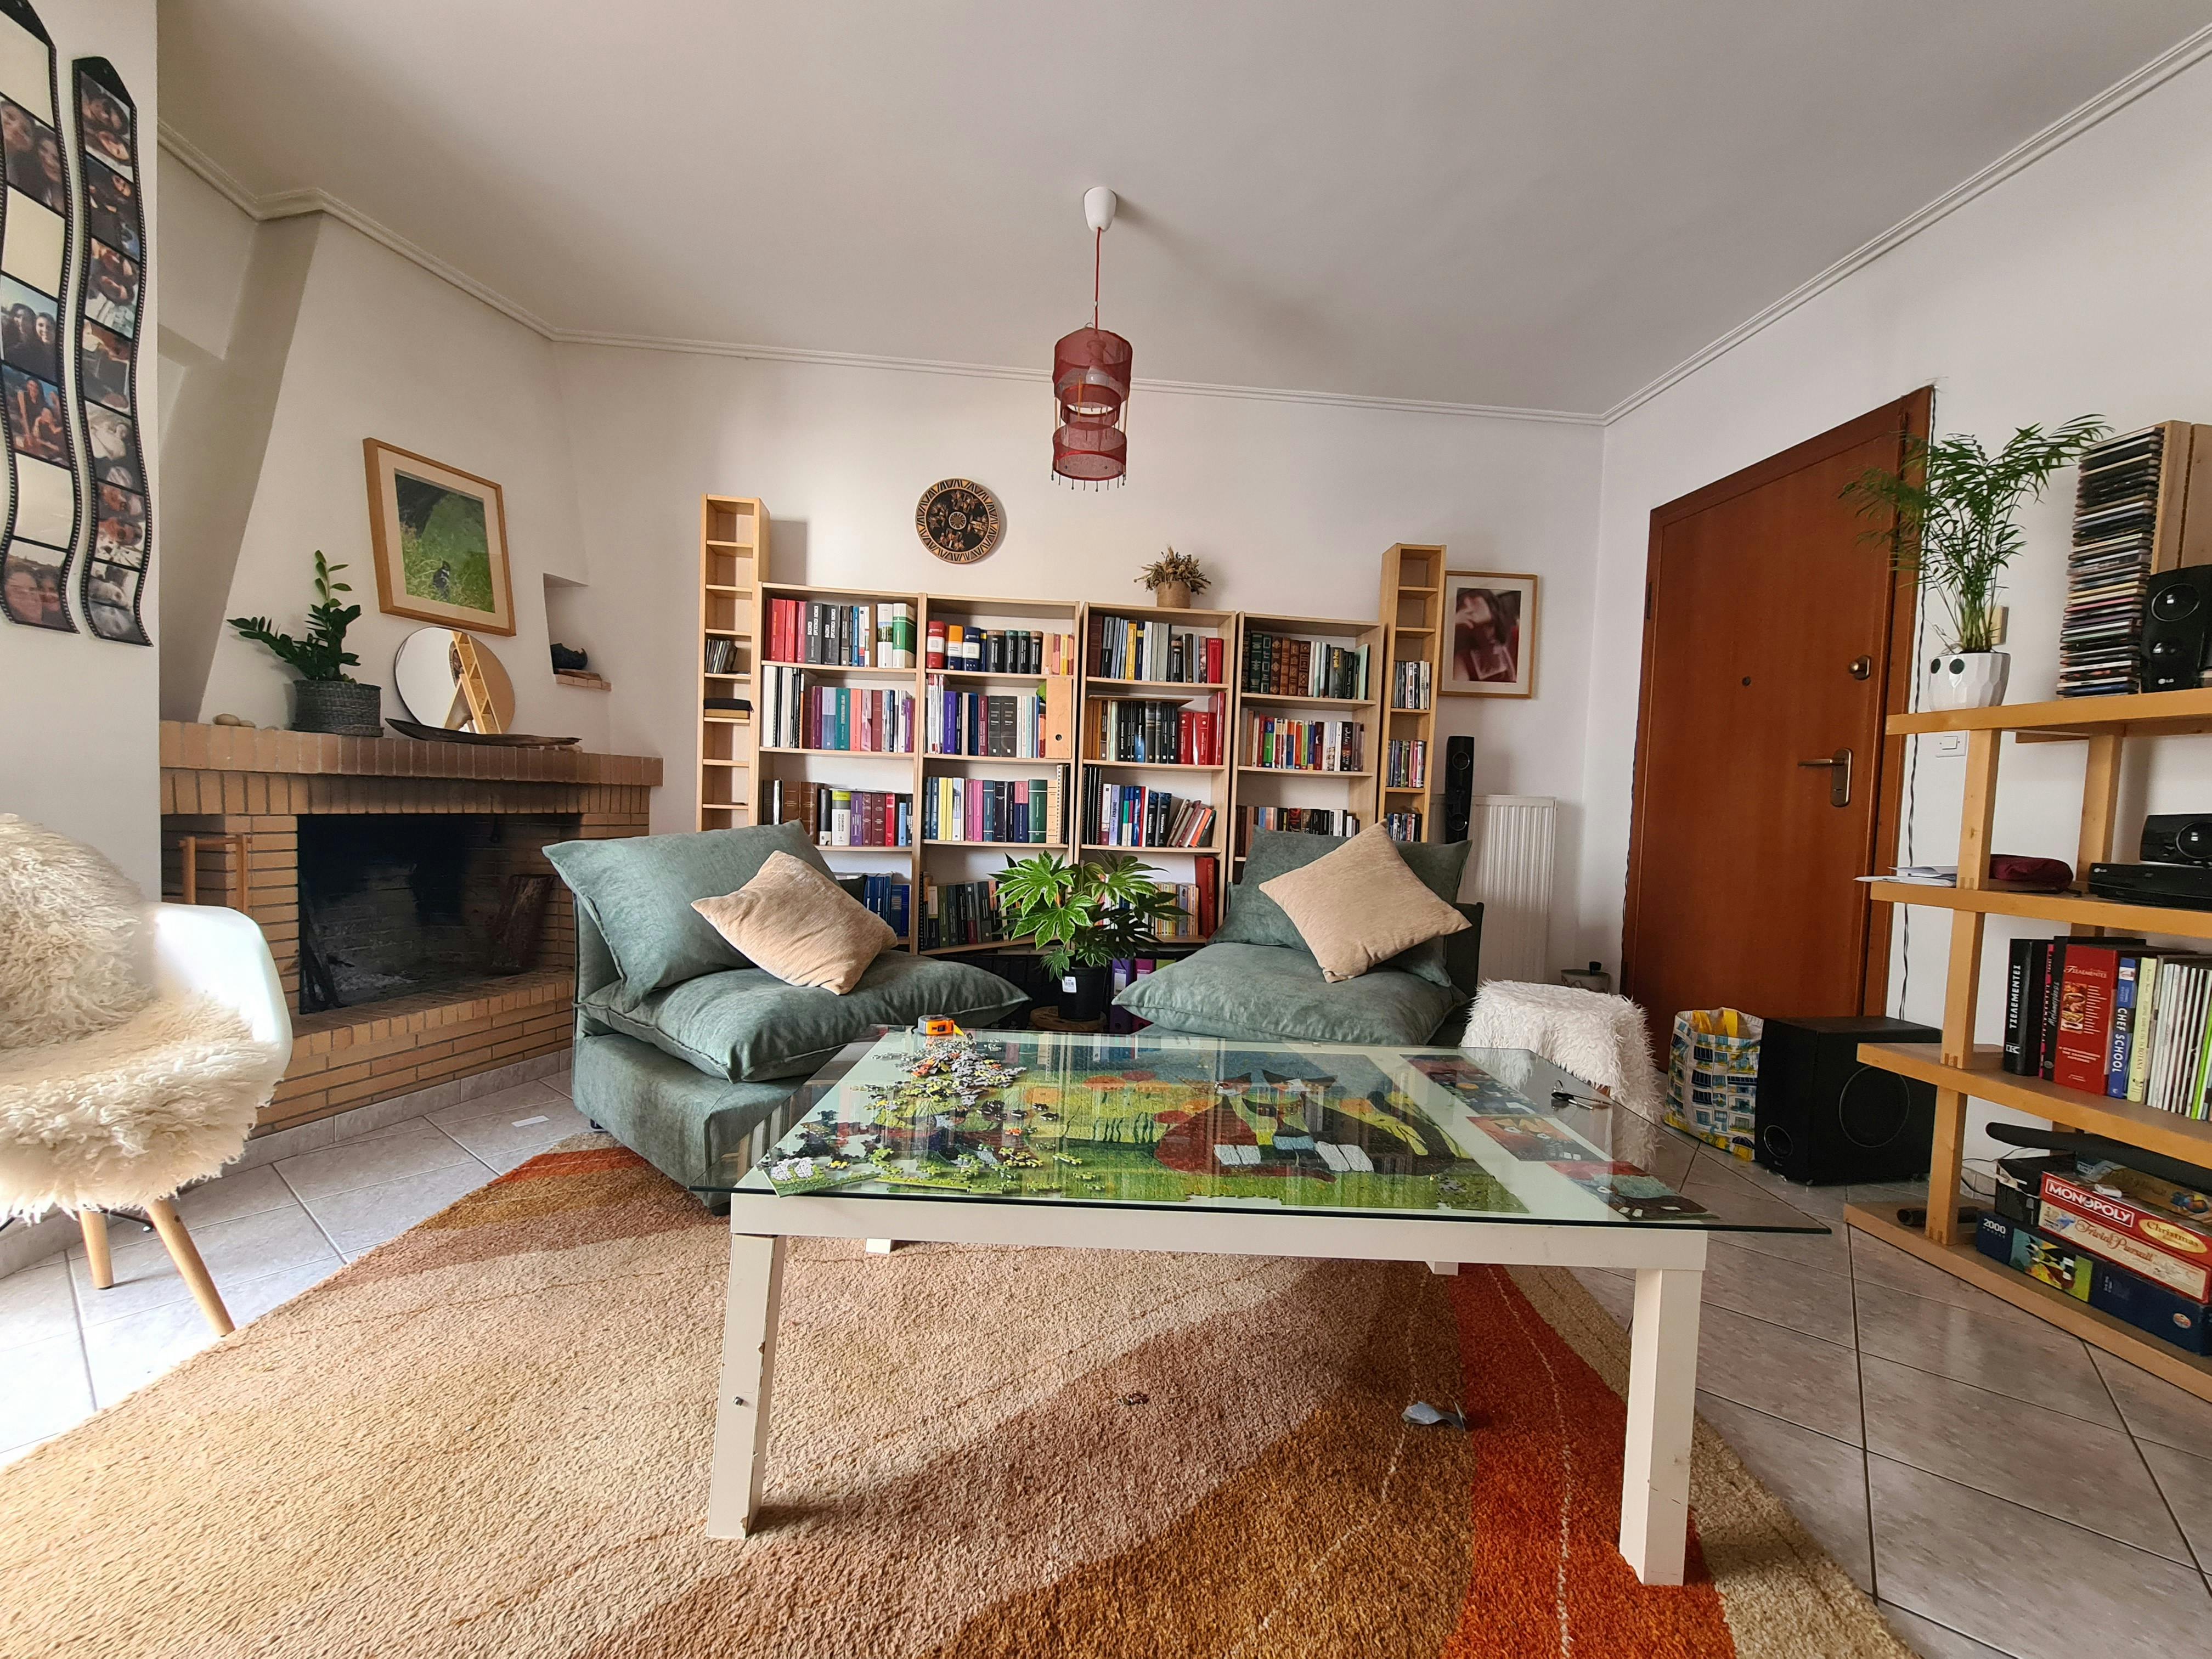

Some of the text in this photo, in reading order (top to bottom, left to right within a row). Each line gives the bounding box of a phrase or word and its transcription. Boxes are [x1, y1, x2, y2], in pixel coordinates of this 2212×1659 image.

[2009, 964, 2021, 1029] ΤΣΕΛΕΜΕΝΤΕΣ
[2116, 1007, 2128, 1031] CHEF
[2112, 1034, 2125, 1073] SCHOOL
[2049, 1182, 2131, 1222] MONOPOLY
[1983, 1218, 2006, 1235] 2000
[2074, 1218, 2154, 1263] Trivial Pursuit
[2146, 1220, 2199, 1248] Christmas
